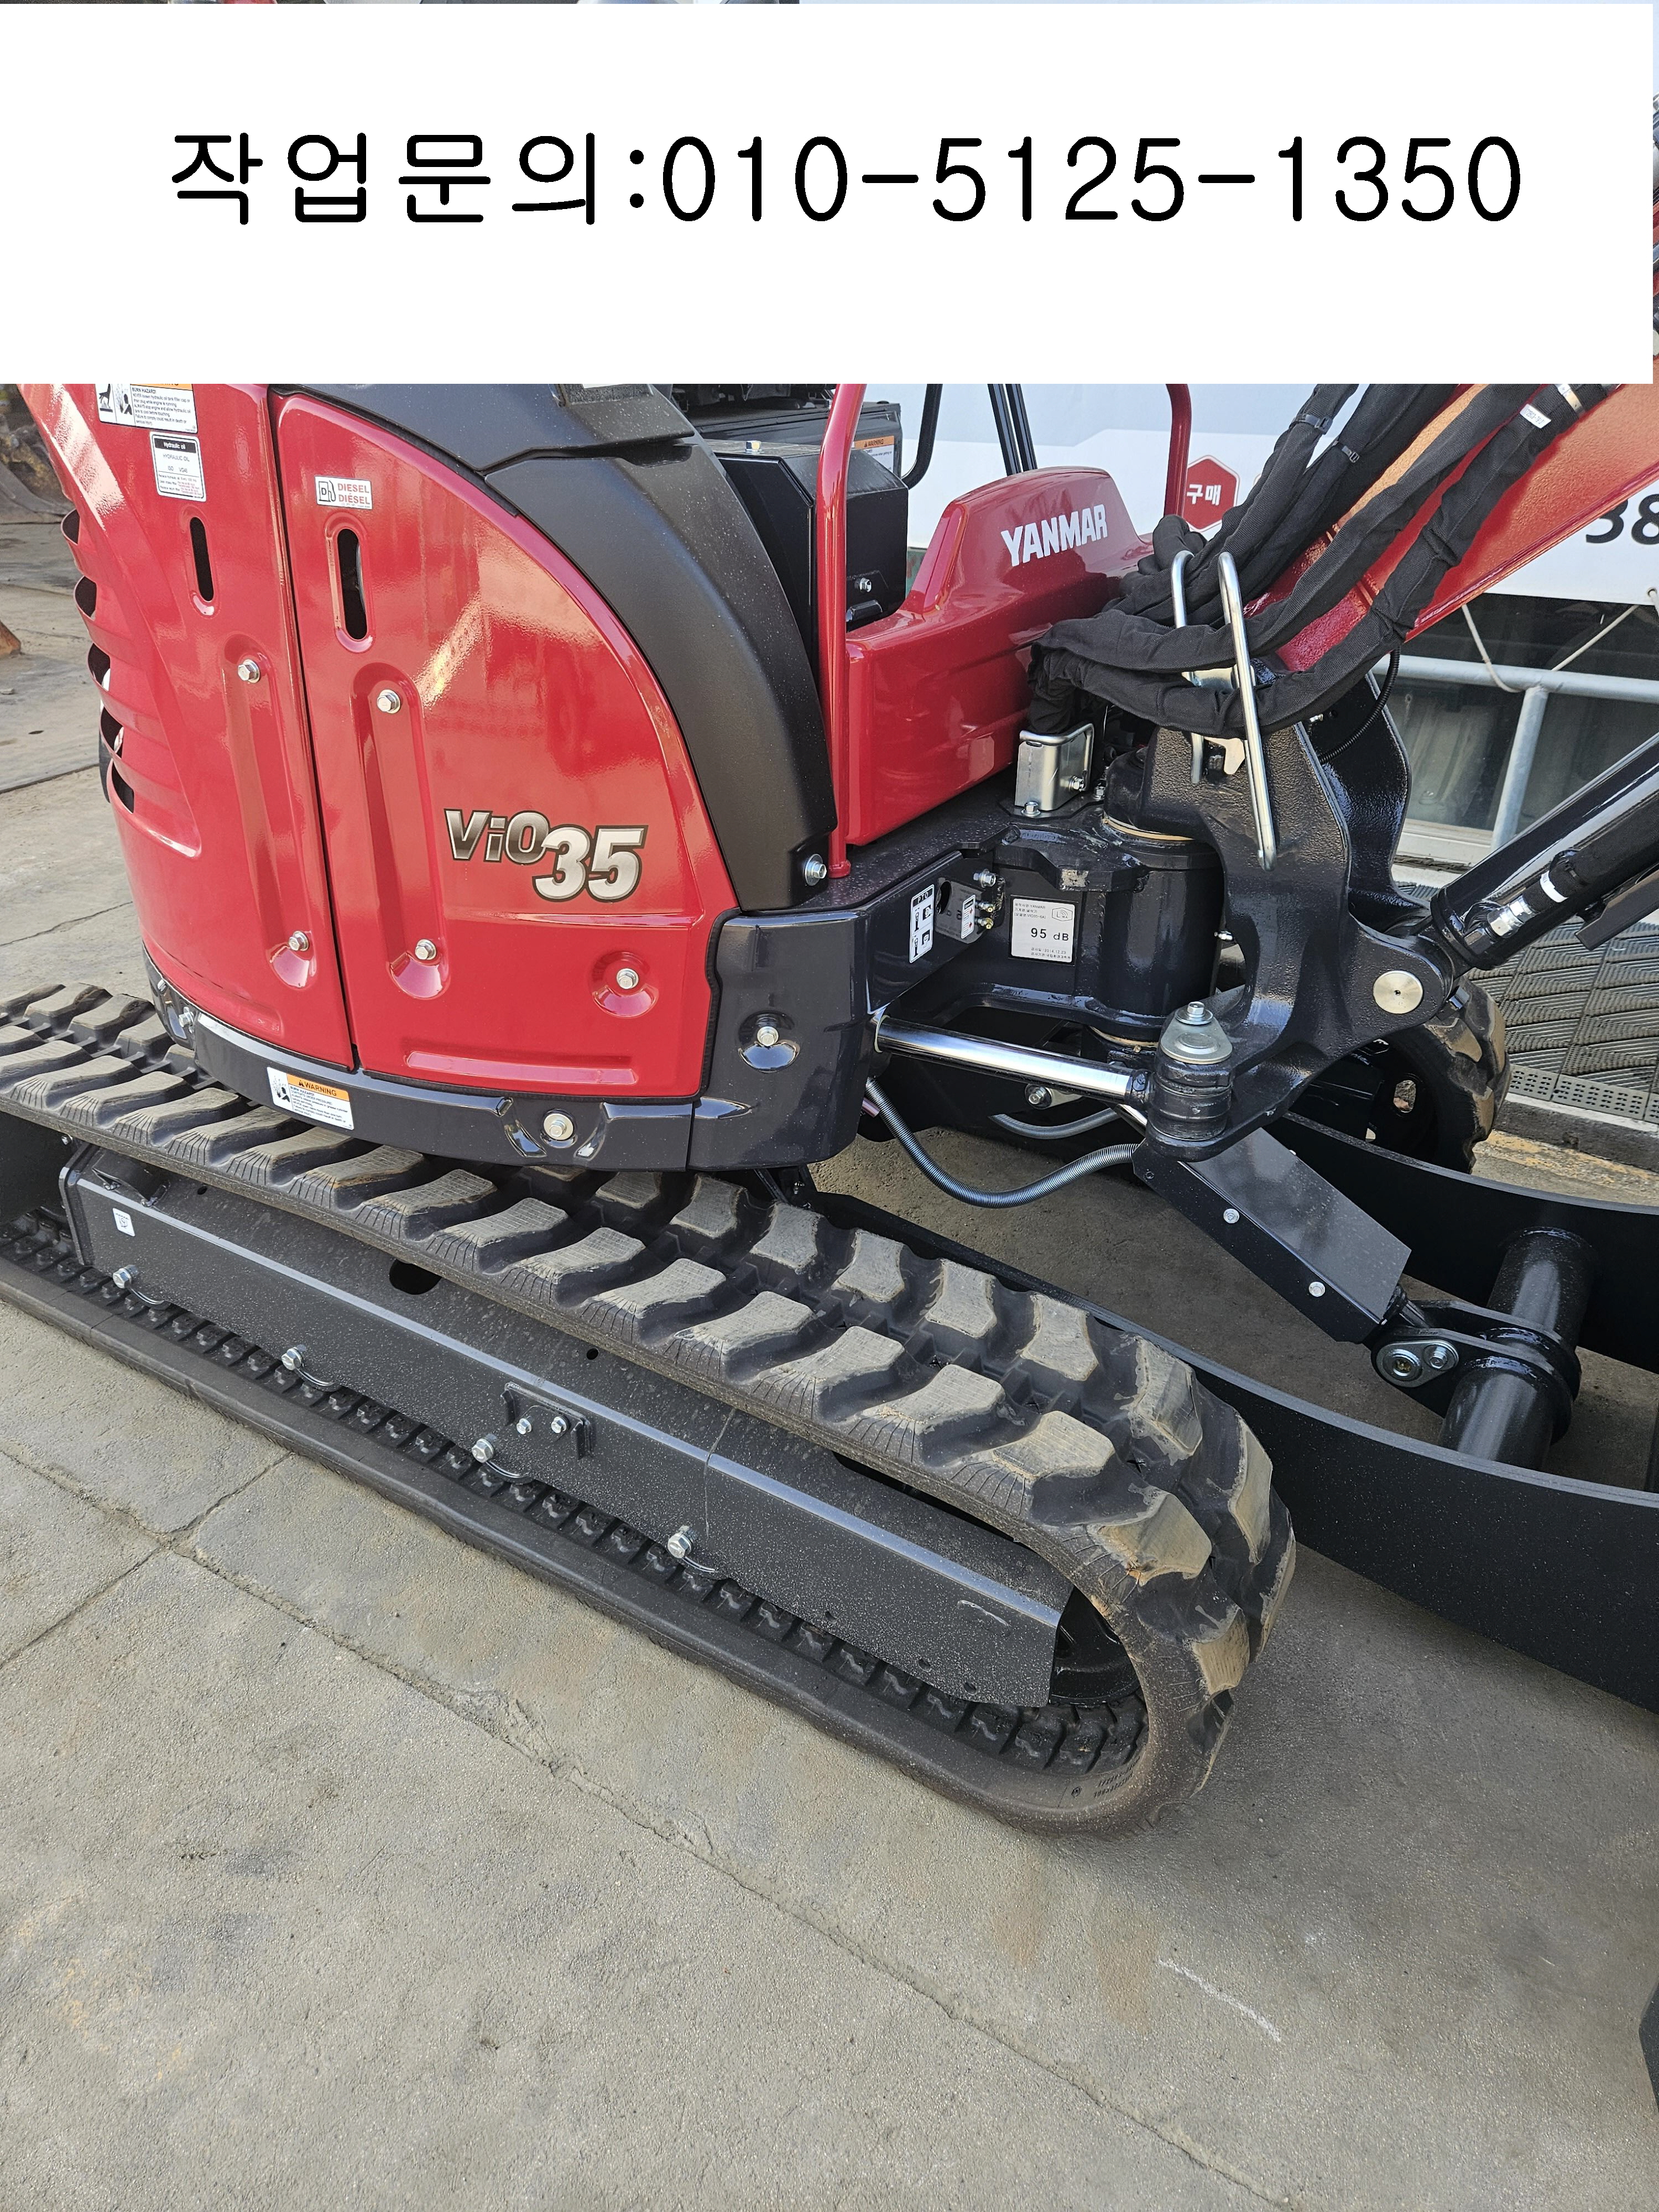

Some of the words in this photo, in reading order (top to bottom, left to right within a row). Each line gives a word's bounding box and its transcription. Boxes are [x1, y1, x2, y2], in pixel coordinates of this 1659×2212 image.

[338, 483, 369, 493] DIESEL
[1187, 484, 1222, 506] 구매
[338, 493, 371, 505] DIÉSEL
[1001, 504, 1108, 567] YANMAR
[918, 891, 928, 904] PTO
[1031, 927, 1047, 938] 95
[1053, 932, 1069, 941] dB
[304, 1081, 337, 1097] WARNING
